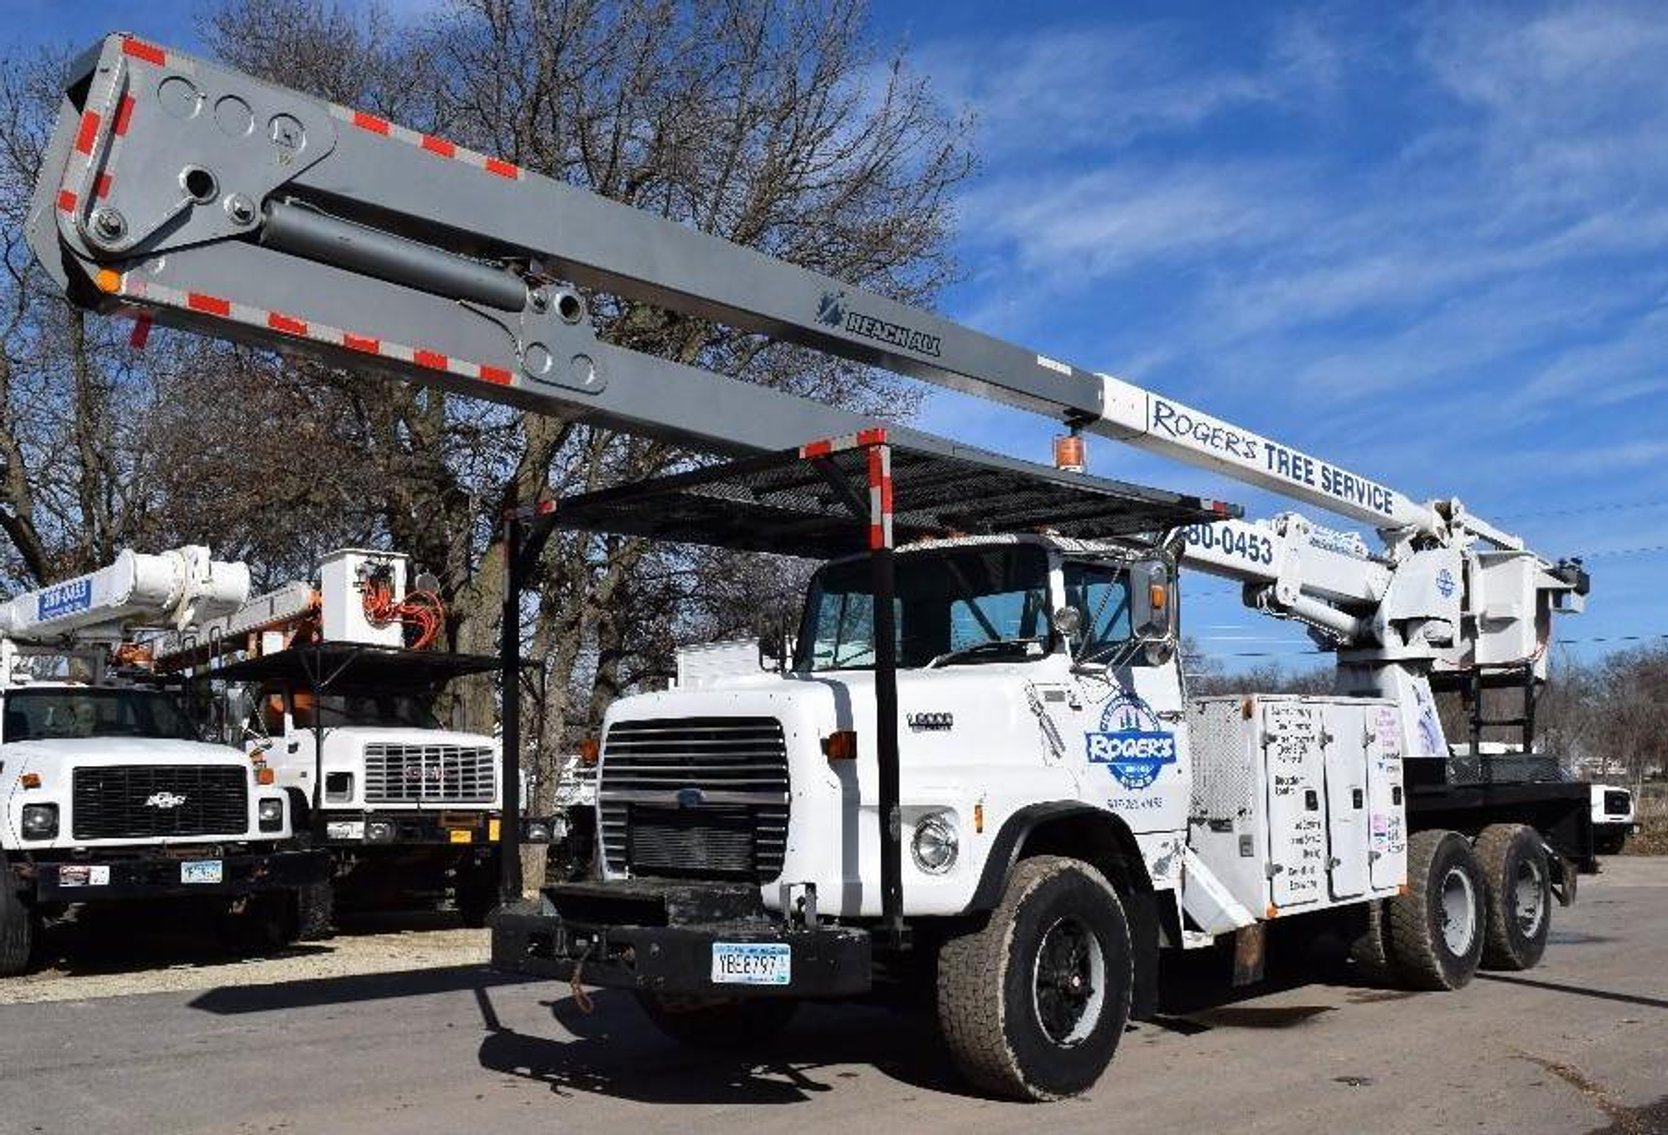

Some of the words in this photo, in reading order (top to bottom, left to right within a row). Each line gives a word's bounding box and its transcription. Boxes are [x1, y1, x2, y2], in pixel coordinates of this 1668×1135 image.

[1153, 400, 1257, 460] ROGER'S
[1264, 443, 1316, 487] TREE
[1321, 464, 1393, 516] SERVICE
